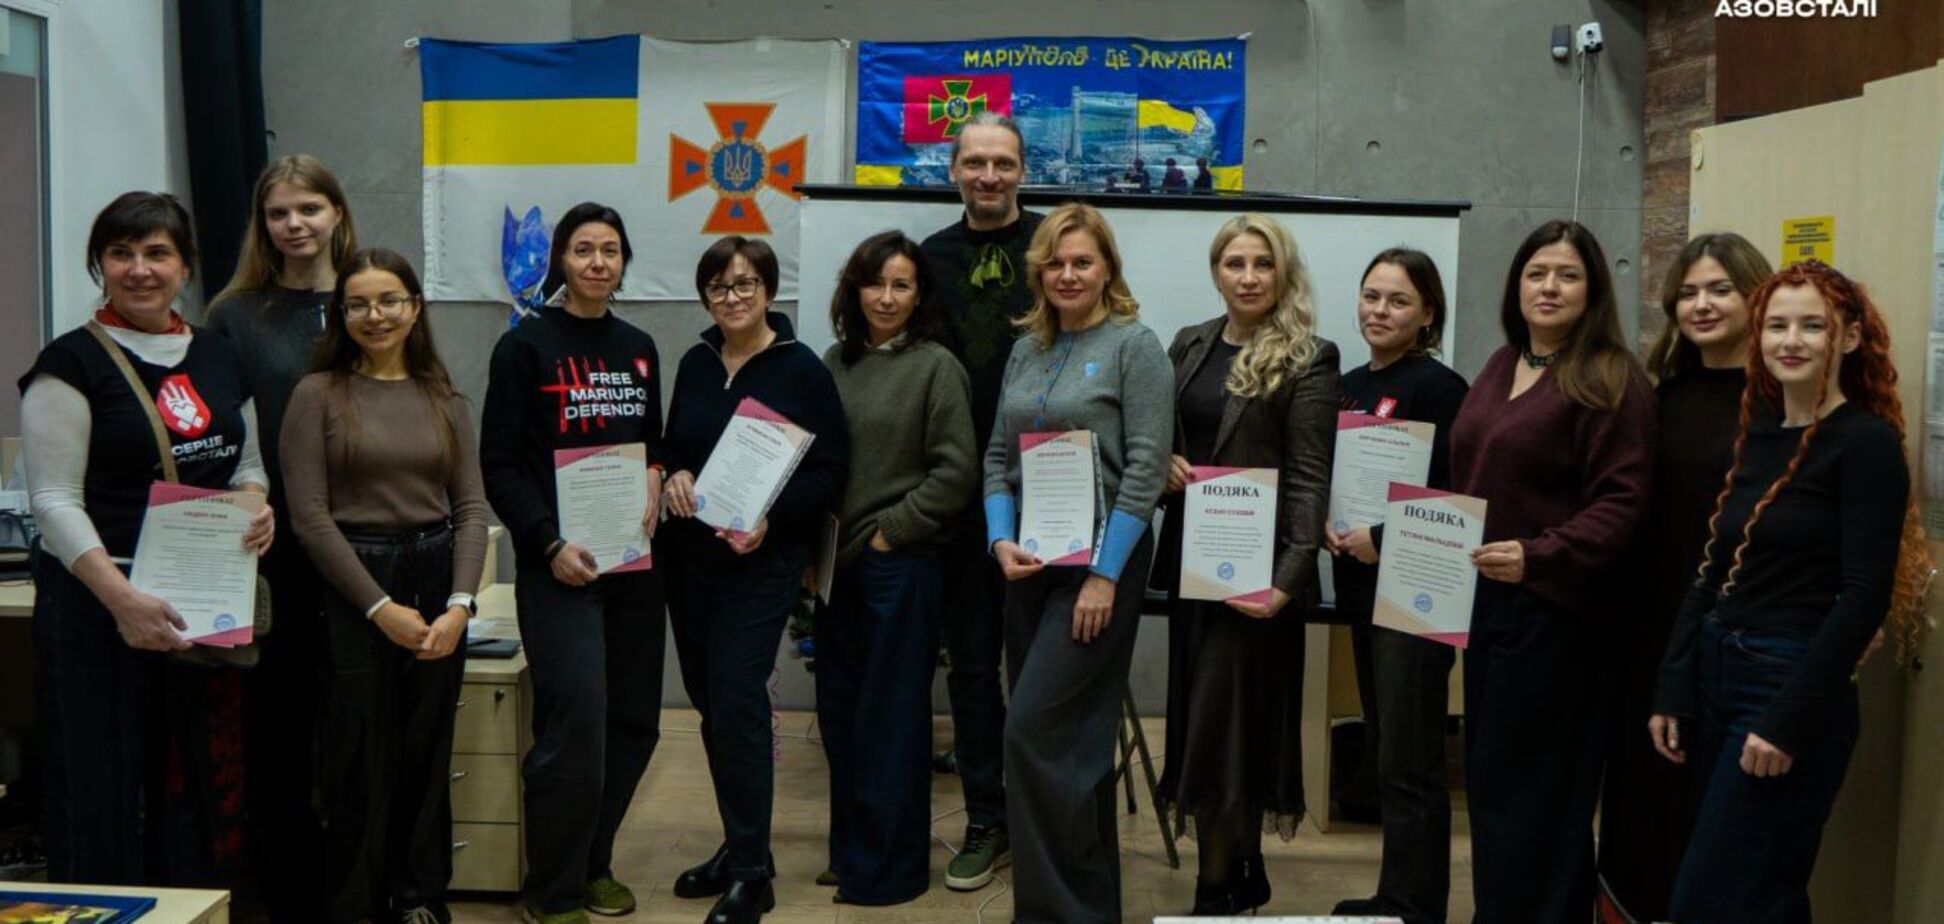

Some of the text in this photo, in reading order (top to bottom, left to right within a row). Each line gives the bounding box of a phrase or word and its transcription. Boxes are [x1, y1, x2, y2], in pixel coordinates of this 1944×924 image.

[1105, 48, 1131, 70] ЦЕ
[589, 372, 633, 385] FREE
[172, 435, 223, 456] СЕРЦЕ
[1202, 484, 1260, 498] ПОДЯКА
[1404, 504, 1466, 529] ПОДЯКА
